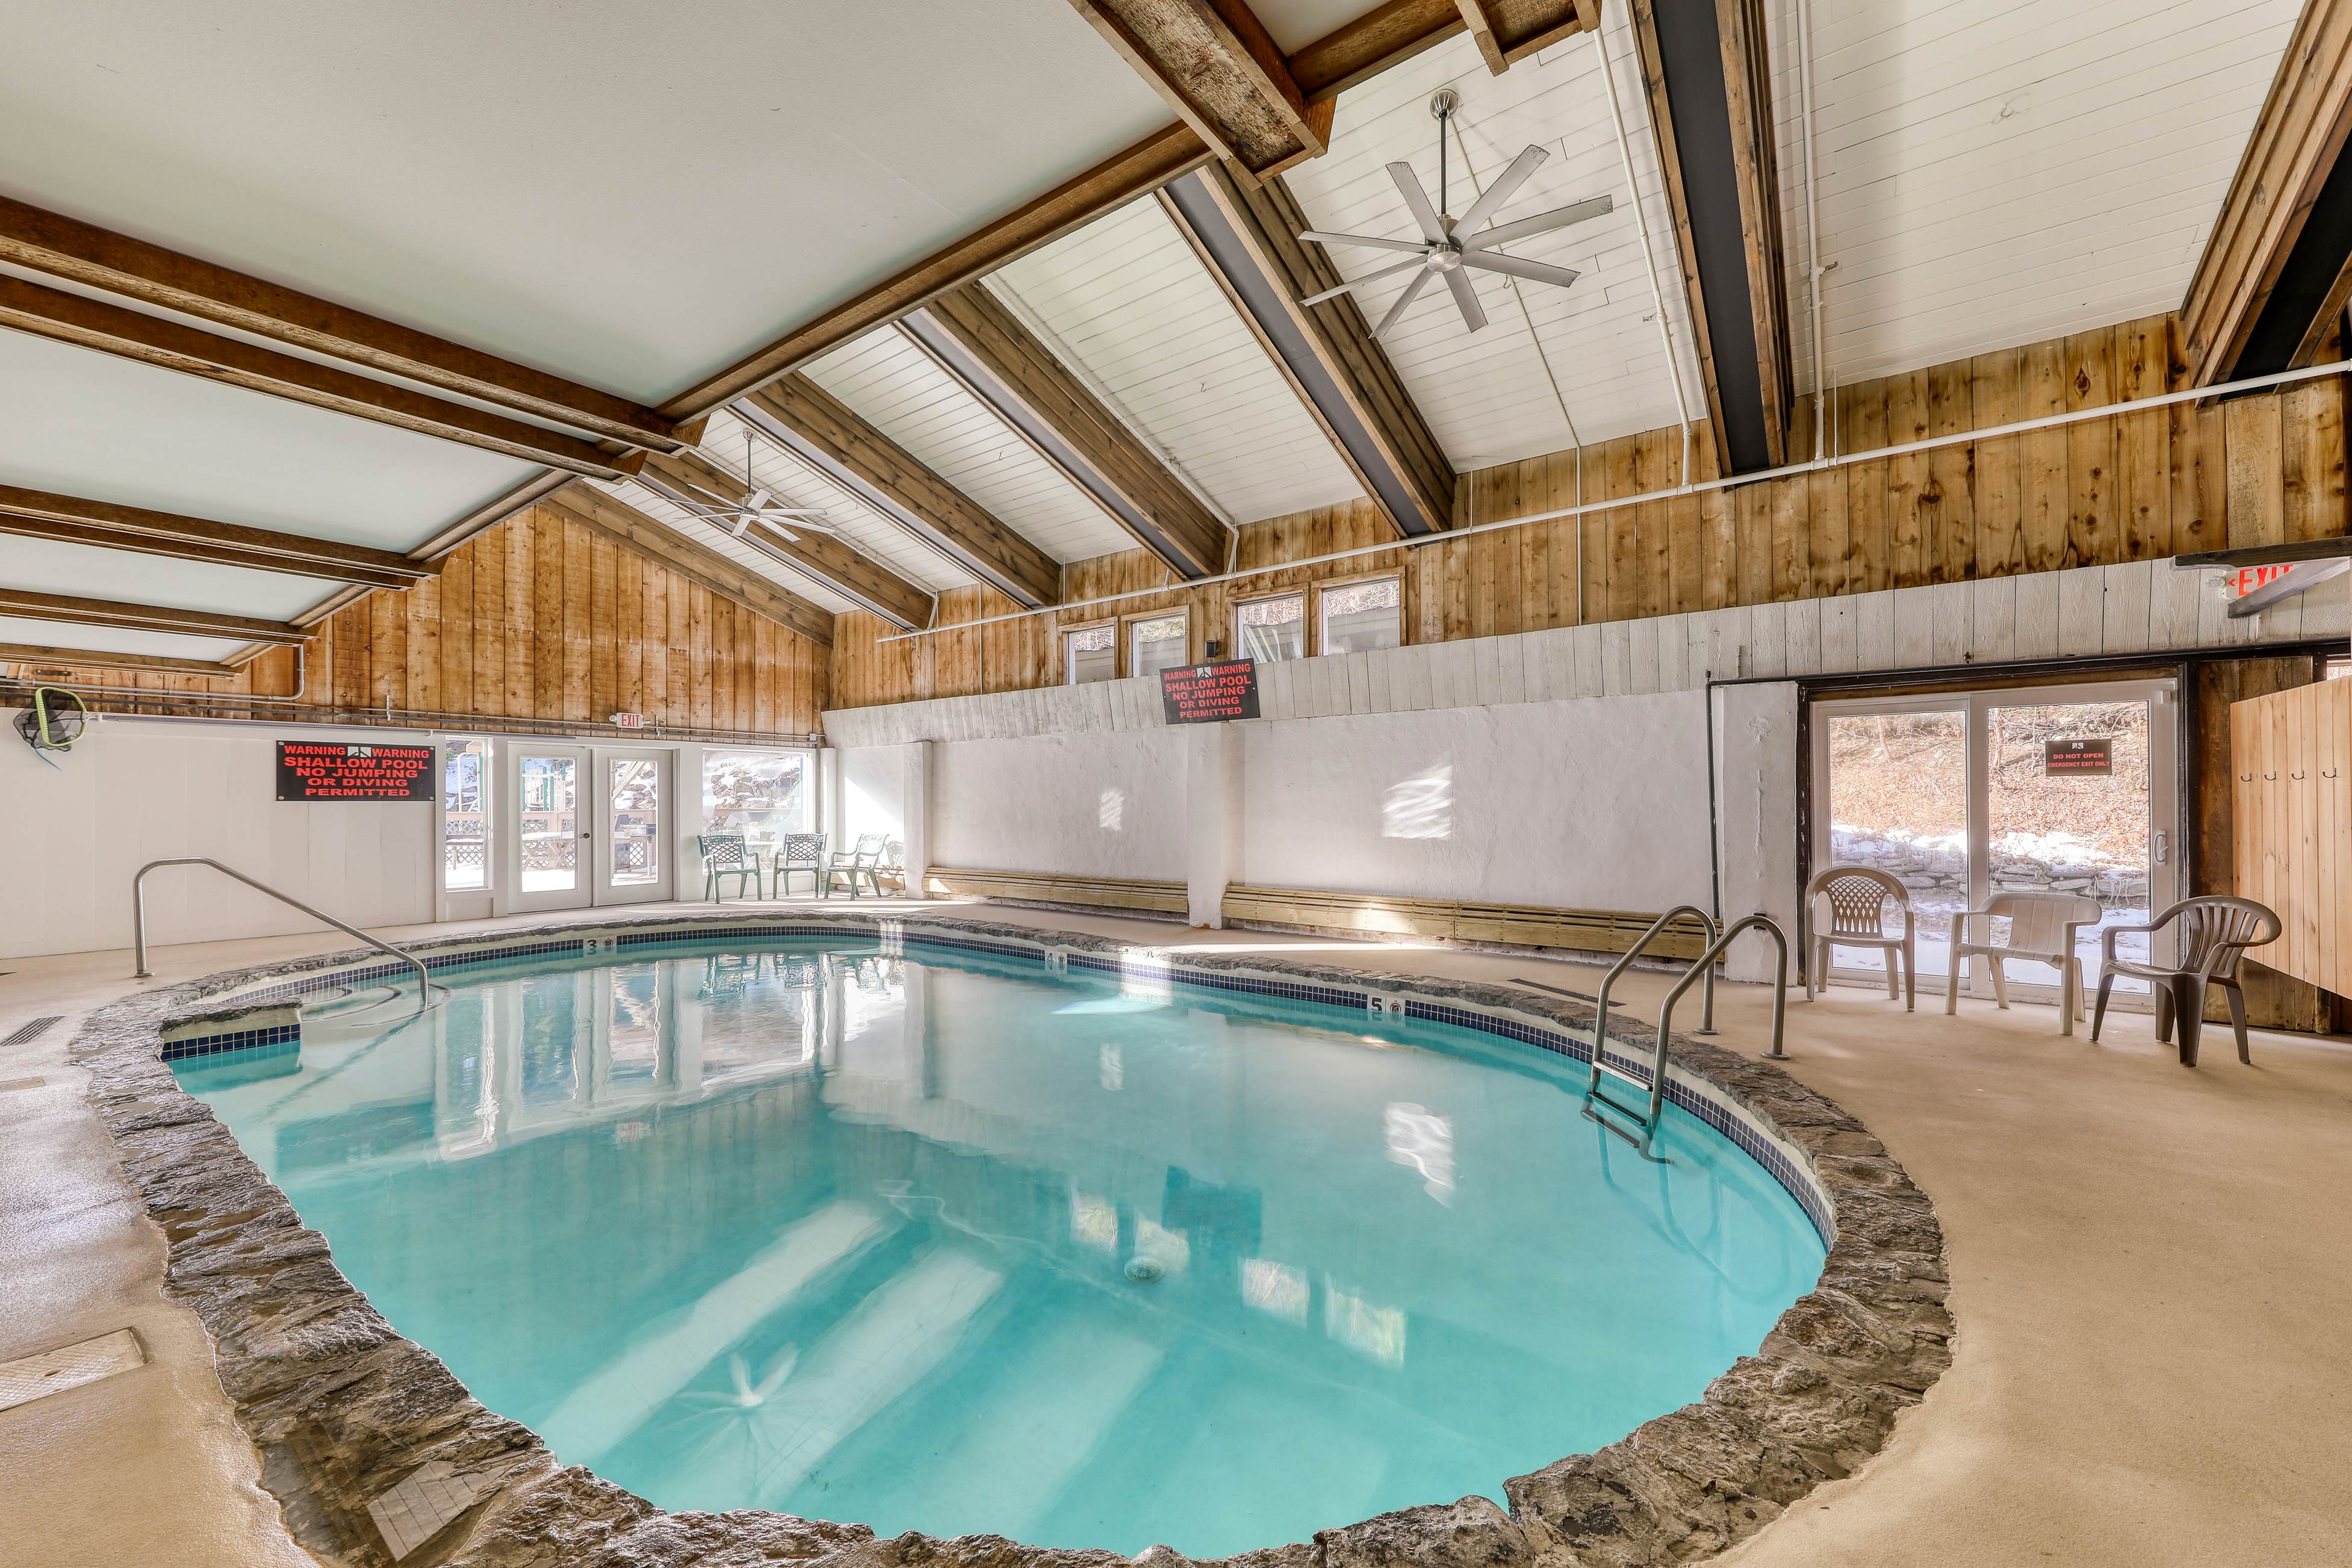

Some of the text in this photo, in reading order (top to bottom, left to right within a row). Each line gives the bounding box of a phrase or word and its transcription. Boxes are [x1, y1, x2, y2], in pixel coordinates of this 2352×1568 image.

[1163, 663, 1251, 681] WARNING WARNING
[1165, 675, 1252, 693] SHALLOW POOL
[1172, 686, 1246, 701] NO JUMPING
[1198, 696, 1240, 708] DIVING
[1179, 707, 1243, 719] PERMITTED
[621, 713, 640, 727] EXIT
[284, 745, 429, 758] WARNING WARNING
[284, 756, 428, 769] SHALLOW POOL
[296, 767, 418, 778] NO JUMPING
[307, 778, 408, 787] OR DIVING
[305, 788, 411, 796] PERMITTED
[1371, 997, 1383, 1011] 5
